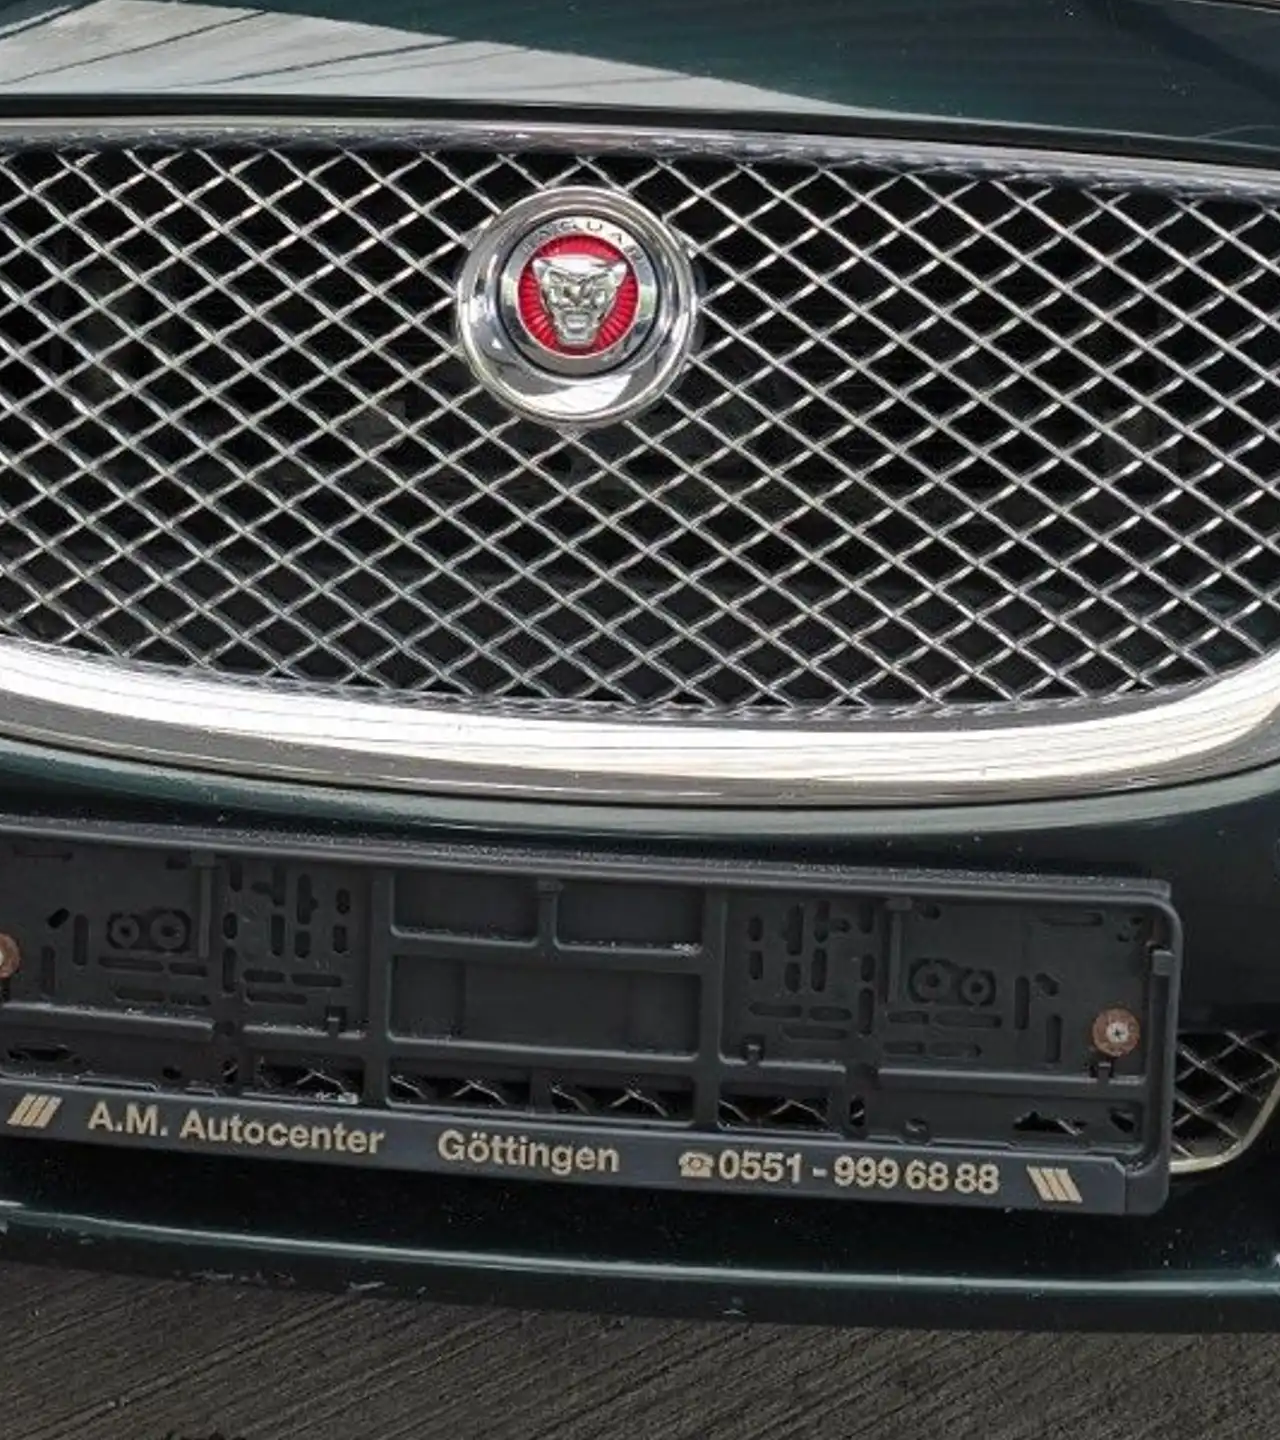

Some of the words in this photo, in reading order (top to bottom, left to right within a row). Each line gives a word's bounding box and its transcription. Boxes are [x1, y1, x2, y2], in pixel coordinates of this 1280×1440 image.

[88, 1102, 168, 1138] A.M.
[179, 1110, 386, 1156] Autocenter
[437, 1129, 620, 1175] Göttingen
[718, 1150, 802, 1184] 0551
